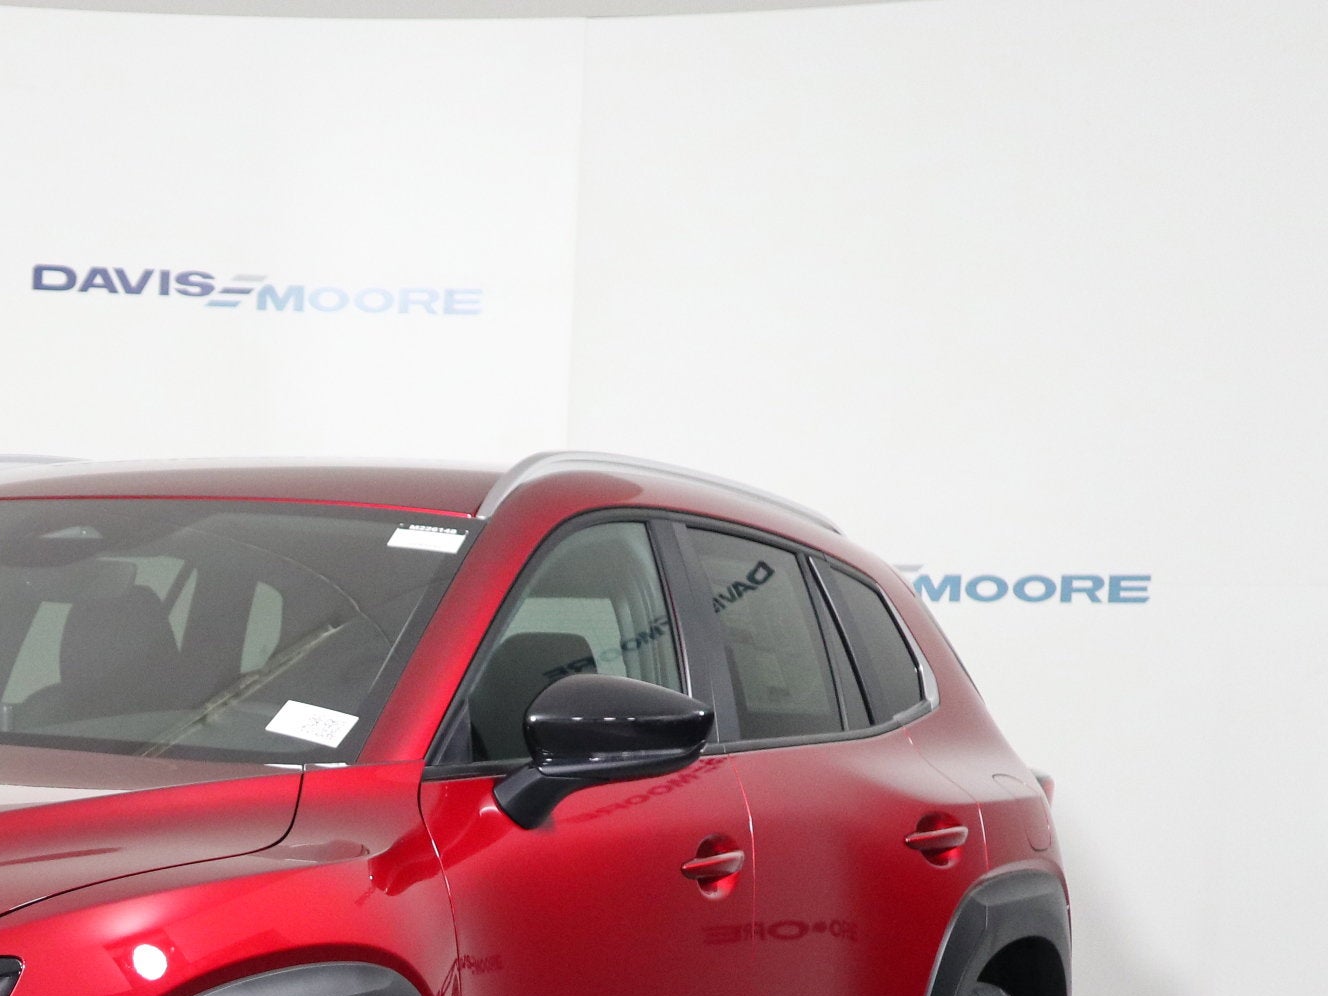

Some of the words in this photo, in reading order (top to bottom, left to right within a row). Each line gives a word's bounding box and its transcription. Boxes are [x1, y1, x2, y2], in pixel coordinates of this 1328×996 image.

[32, 264, 215, 297] DAVIS
[256, 284, 483, 315] MOORE
[913, 574, 1152, 603] MOORE
